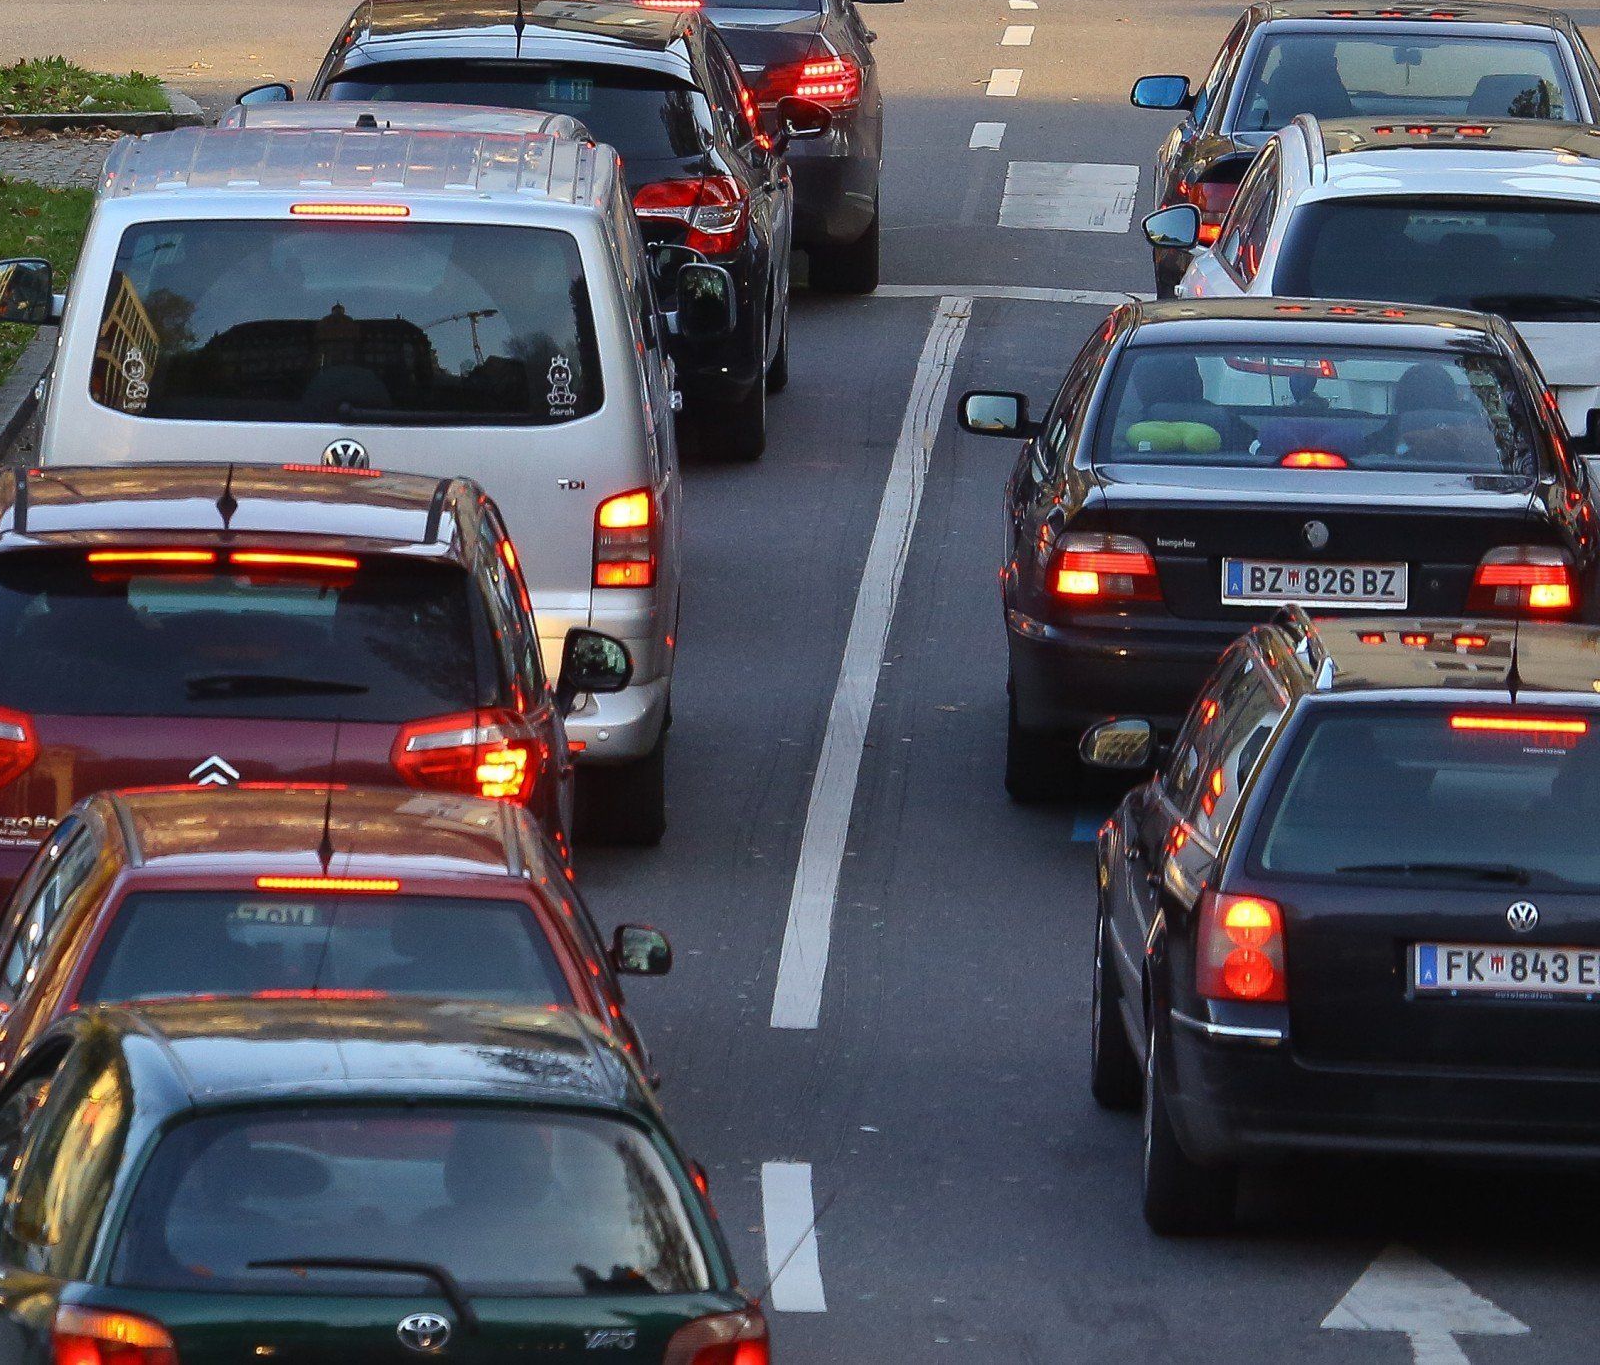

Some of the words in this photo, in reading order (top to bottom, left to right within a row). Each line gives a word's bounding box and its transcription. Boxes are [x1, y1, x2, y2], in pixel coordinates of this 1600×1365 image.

[557, 478, 586, 490] TDI
[1156, 536, 1196, 549] baumgartner
[1250, 567, 1283, 594] BZ
[1304, 567, 1355, 595] 826
[1362, 569, 1396, 596] BZ
[1446, 950, 1486, 981] FK
[1510, 952, 1570, 983] 843
[1578, 954, 1600, 985] E
